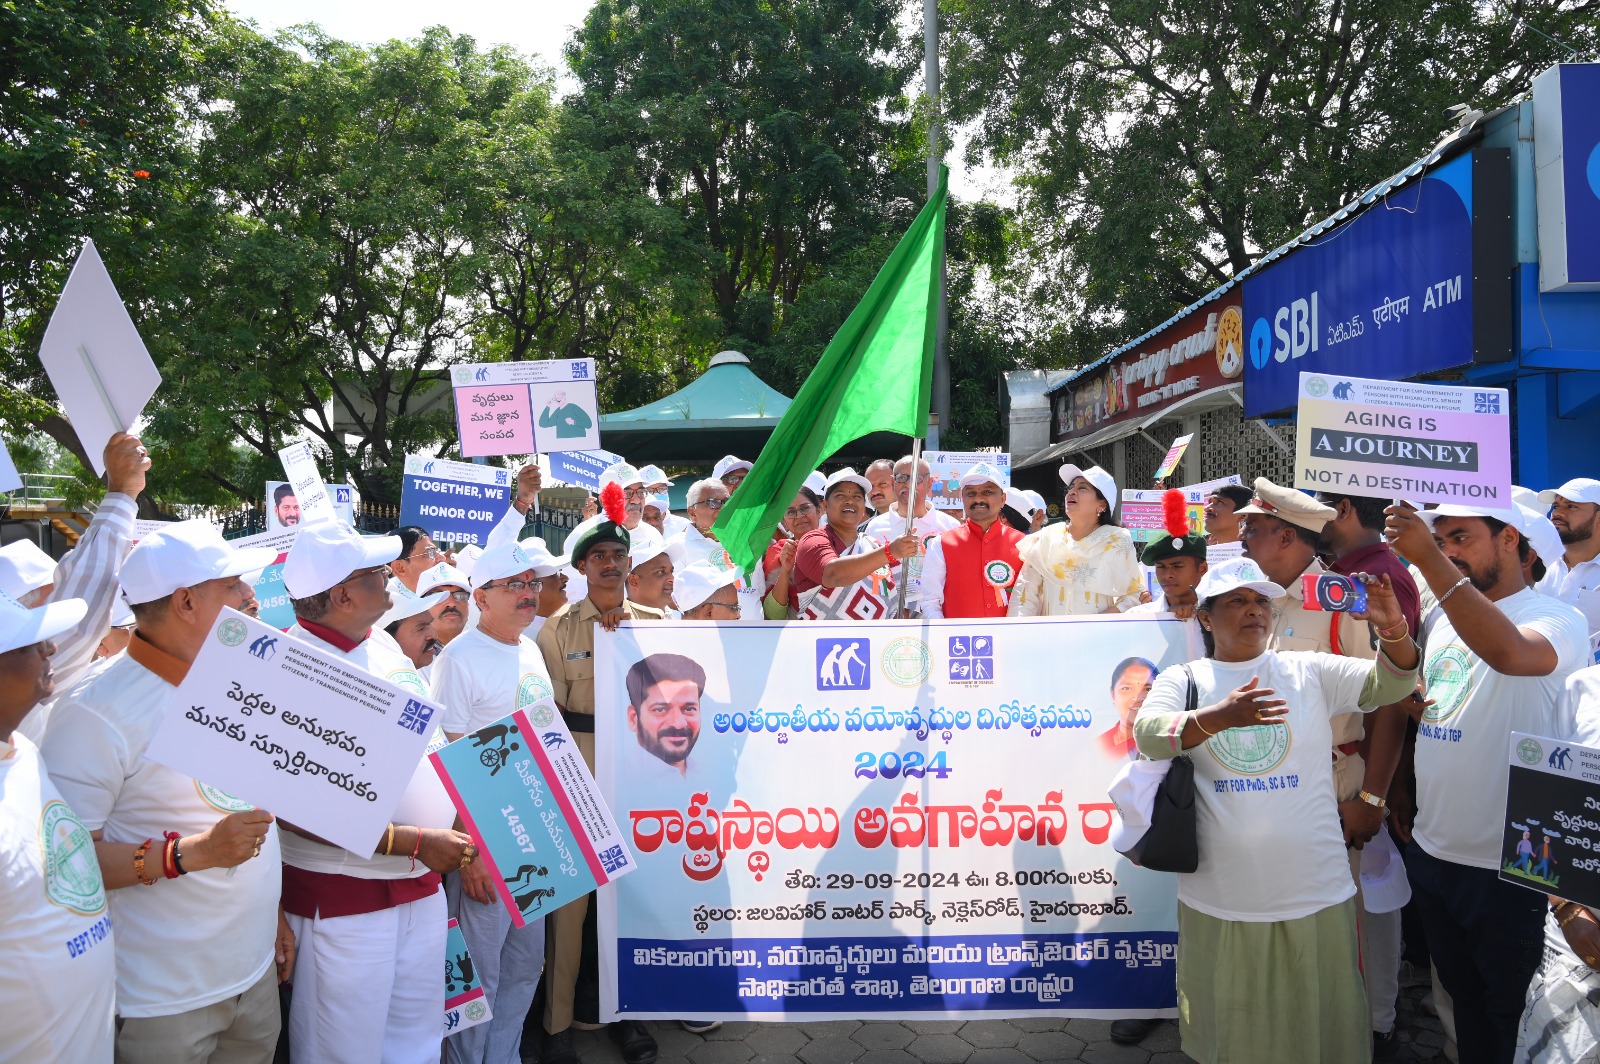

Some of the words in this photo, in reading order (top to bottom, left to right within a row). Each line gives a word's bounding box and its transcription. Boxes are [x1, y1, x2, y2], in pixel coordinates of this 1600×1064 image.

[1422, 274, 1461, 313] ATM
[1274, 291, 1318, 363] SBI
[1372, 296, 1410, 329] एटीएम
[472, 392, 514, 407] వృద్ధులు
[1363, 384, 1398, 393] DEPARTMENT
[1411, 388, 1453, 396] EMPOWERMENT
[1364, 391, 1388, 400] PERSONS
[1394, 401, 1433, 410] TRANSGENDER
[470, 411, 494, 422] మన
[496, 409, 520, 426] జ్ఞాన
[1344, 410, 1411, 430] AGING
[1419, 417, 1437, 432] IS
[479, 428, 515, 440] సంపద
[1315, 433, 1333, 452] A
[1339, 436, 1473, 465] JOURNEY
[562, 461, 597, 480] HONOR
[1305, 468, 1343, 485] NOT
[1348, 473, 1360, 487] A
[1366, 475, 1498, 499] DESTINATION
[413, 479, 482, 500] TOGETHER,
[484, 487, 504, 500] WE
[419, 504, 466, 519] HONOR
[467, 508, 494, 522] OUR
[432, 530, 479, 544] ELDERS
[284, 655, 313, 671] PERSONS
[313, 668, 329, 678] WITH
[329, 675, 368, 697] DISABILITIES,
[369, 693, 391, 707] SENIOR
[288, 646, 329, 668] DEPARTMENT
[329, 665, 341, 673] FOR
[341, 670, 388, 695] EMPOWERMENT
[387, 691, 396, 699] OF
[226, 681, 277, 716] పెద్దల
[281, 663, 309, 679] CITIZENS
[316, 679, 358, 702] TRANSGENDER
[358, 699, 387, 715] PERSONS
[185, 705, 247, 742] మనకు
[713, 703, 840, 745] అంతర్జాతీయ
[844, 705, 972, 745] వయోవృద్ధుల
[976, 699, 1093, 738] దినోత్సవము
[1433, 726, 1442, 740] SC
[1442, 728, 1447, 740] &
[1449, 728, 1462, 743] TGP
[854, 750, 953, 780] 2024
[559, 755, 574, 777] PERSONS
[571, 777, 580, 790] WITH
[592, 821, 605, 839] SENIOR
[566, 752, 585, 783] DEPARTMENT
[582, 783, 590, 793] FOR
[586, 793, 608, 829] EMPOWERMENT
[1213, 779, 1229, 793] DEPT
[1230, 778, 1246, 793] FOR
[1247, 777, 1269, 793] PwDs,
[1269, 776, 1279, 790] SC
[1280, 775, 1286, 789] &
[1286, 774, 1299, 788] TGP
[553, 759, 568, 781] CITIZENS
[566, 786, 588, 820] TRANSGENDER
[583, 819, 598, 842] PERSONS
[500, 804, 536, 854] 14567
[629, 791, 840, 882] రాష్ట్రస్థాయి
[854, 787, 1068, 849] అవగాహన
[1564, 835, 1591, 850] వారి
[785, 868, 822, 889] తేది:
[826, 872, 961, 889] 29-09-2024
[692, 904, 742, 934] స్థలం:
[746, 900, 827, 922] జలవిహార్
[831, 900, 885, 921] వాటర్
[1029, 895, 1133, 923] హైదరాబాద్.
[66, 930, 92, 959] DEPT
[89, 917, 107, 946] FOR
[633, 946, 763, 969] వికలాంగులు,
[767, 944, 897, 975] వయోవృద్ధులు
[902, 943, 982, 965] మరియు
[738, 977, 845, 1000] సాధికారత
[851, 978, 903, 999] శాఖ,
[909, 975, 1006, 995] తెలంగాణ
[1010, 972, 1074, 1002] రాష్ట్రం
